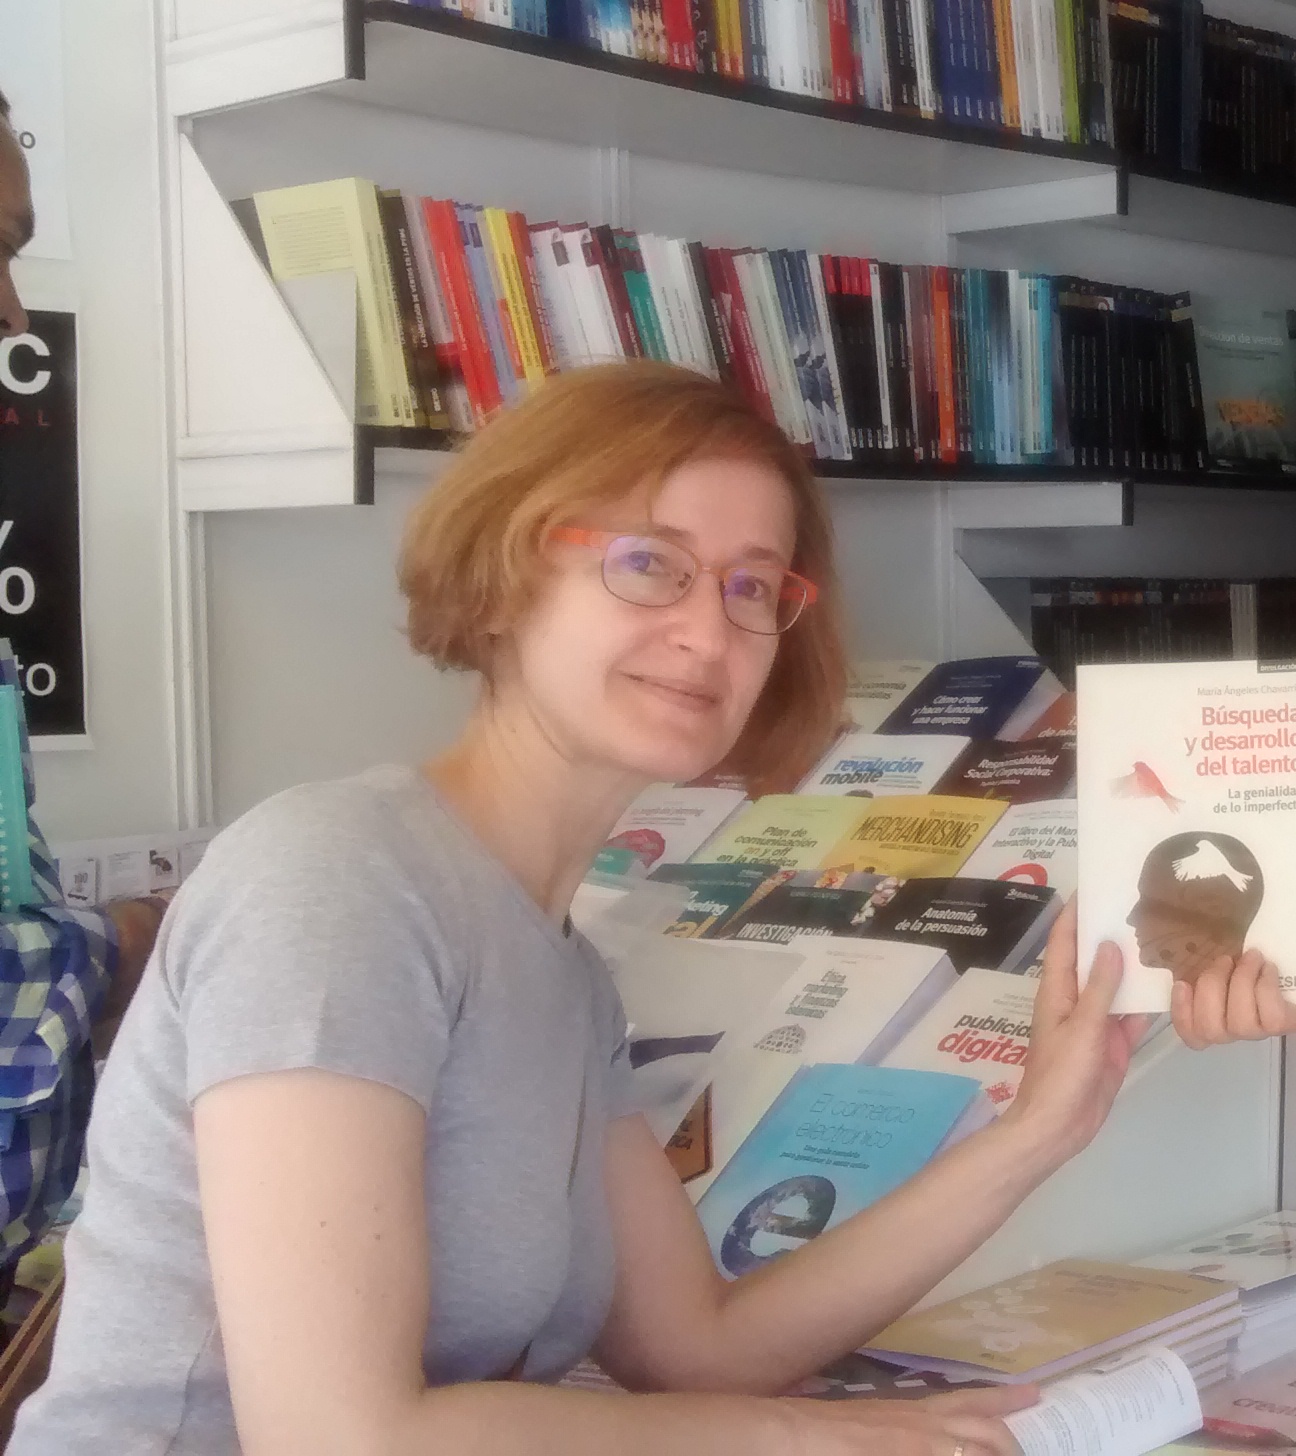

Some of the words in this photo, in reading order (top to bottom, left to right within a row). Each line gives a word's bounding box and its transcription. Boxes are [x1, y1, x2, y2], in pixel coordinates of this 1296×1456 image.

[1197, 686, 1222, 696] María
[1224, 685, 1259, 696] Ángeles
[945, 705, 989, 714] funcionar
[1184, 736, 1197, 756] y
[833, 756, 925, 774] revolución
[978, 754, 1059, 769] Responsabilidad
[1196, 756, 1228, 776] del
[820, 770, 884, 786] mobile
[963, 768, 995, 779] Social
[1228, 788, 1241, 799] La
[1213, 802, 1228, 814] de
[1230, 802, 1241, 813] lo
[762, 826, 791, 838] Plan
[791, 827, 808, 838] de
[850, 815, 979, 850] MERCHANDISING
[1019, 826, 1040, 837] libro
[1041, 826, 1054, 836] del
[734, 835, 818, 848] comunicación
[992, 838, 1038, 849] Interactivo
[1022, 849, 1055, 860] Digital
[921, 907, 978, 922] Anatomía
[895, 920, 911, 931] de
[912, 920, 922, 931] la
[921, 921, 988, 937] persuasión
[937, 1029, 1028, 1064] digita
[831, 1100, 915, 1124] comercio
